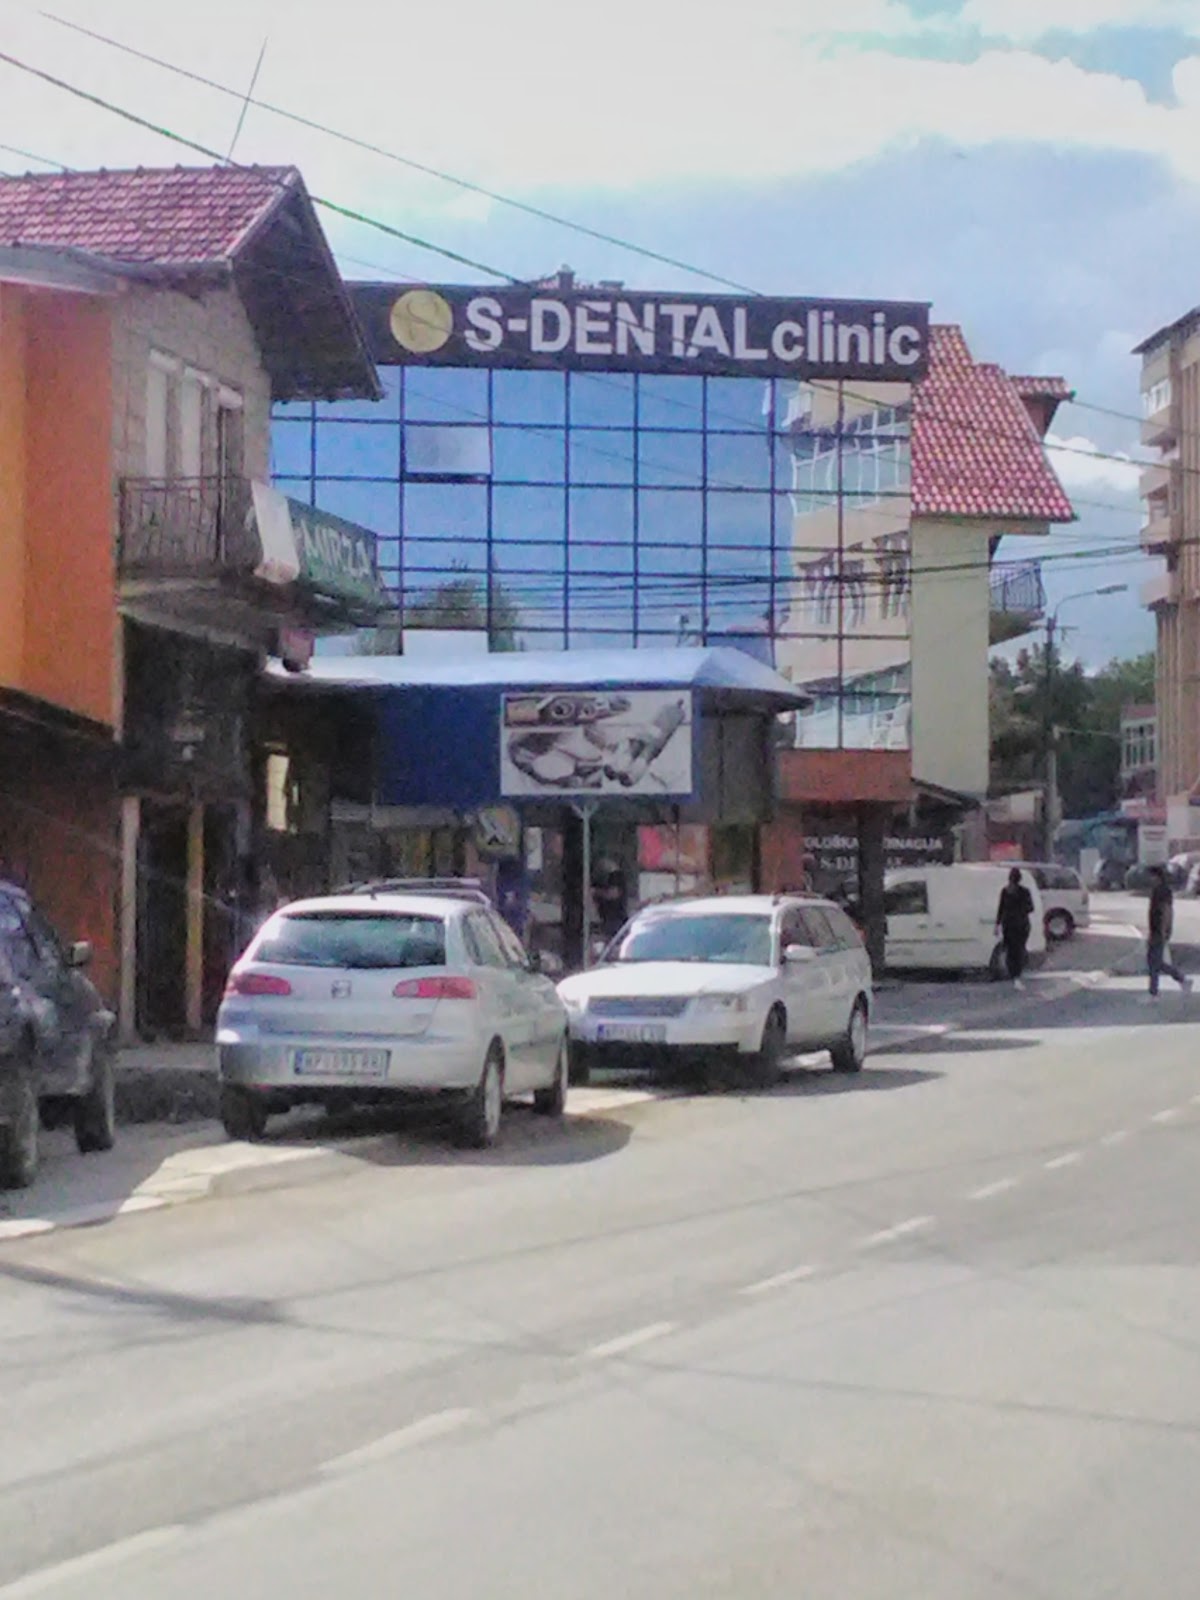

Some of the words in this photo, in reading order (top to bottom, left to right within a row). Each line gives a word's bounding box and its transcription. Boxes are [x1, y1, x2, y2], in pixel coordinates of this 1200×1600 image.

[463, 296, 768, 361] S-DENTAL
[770, 307, 922, 366] clinic
[299, 517, 370, 578] MIRZA
